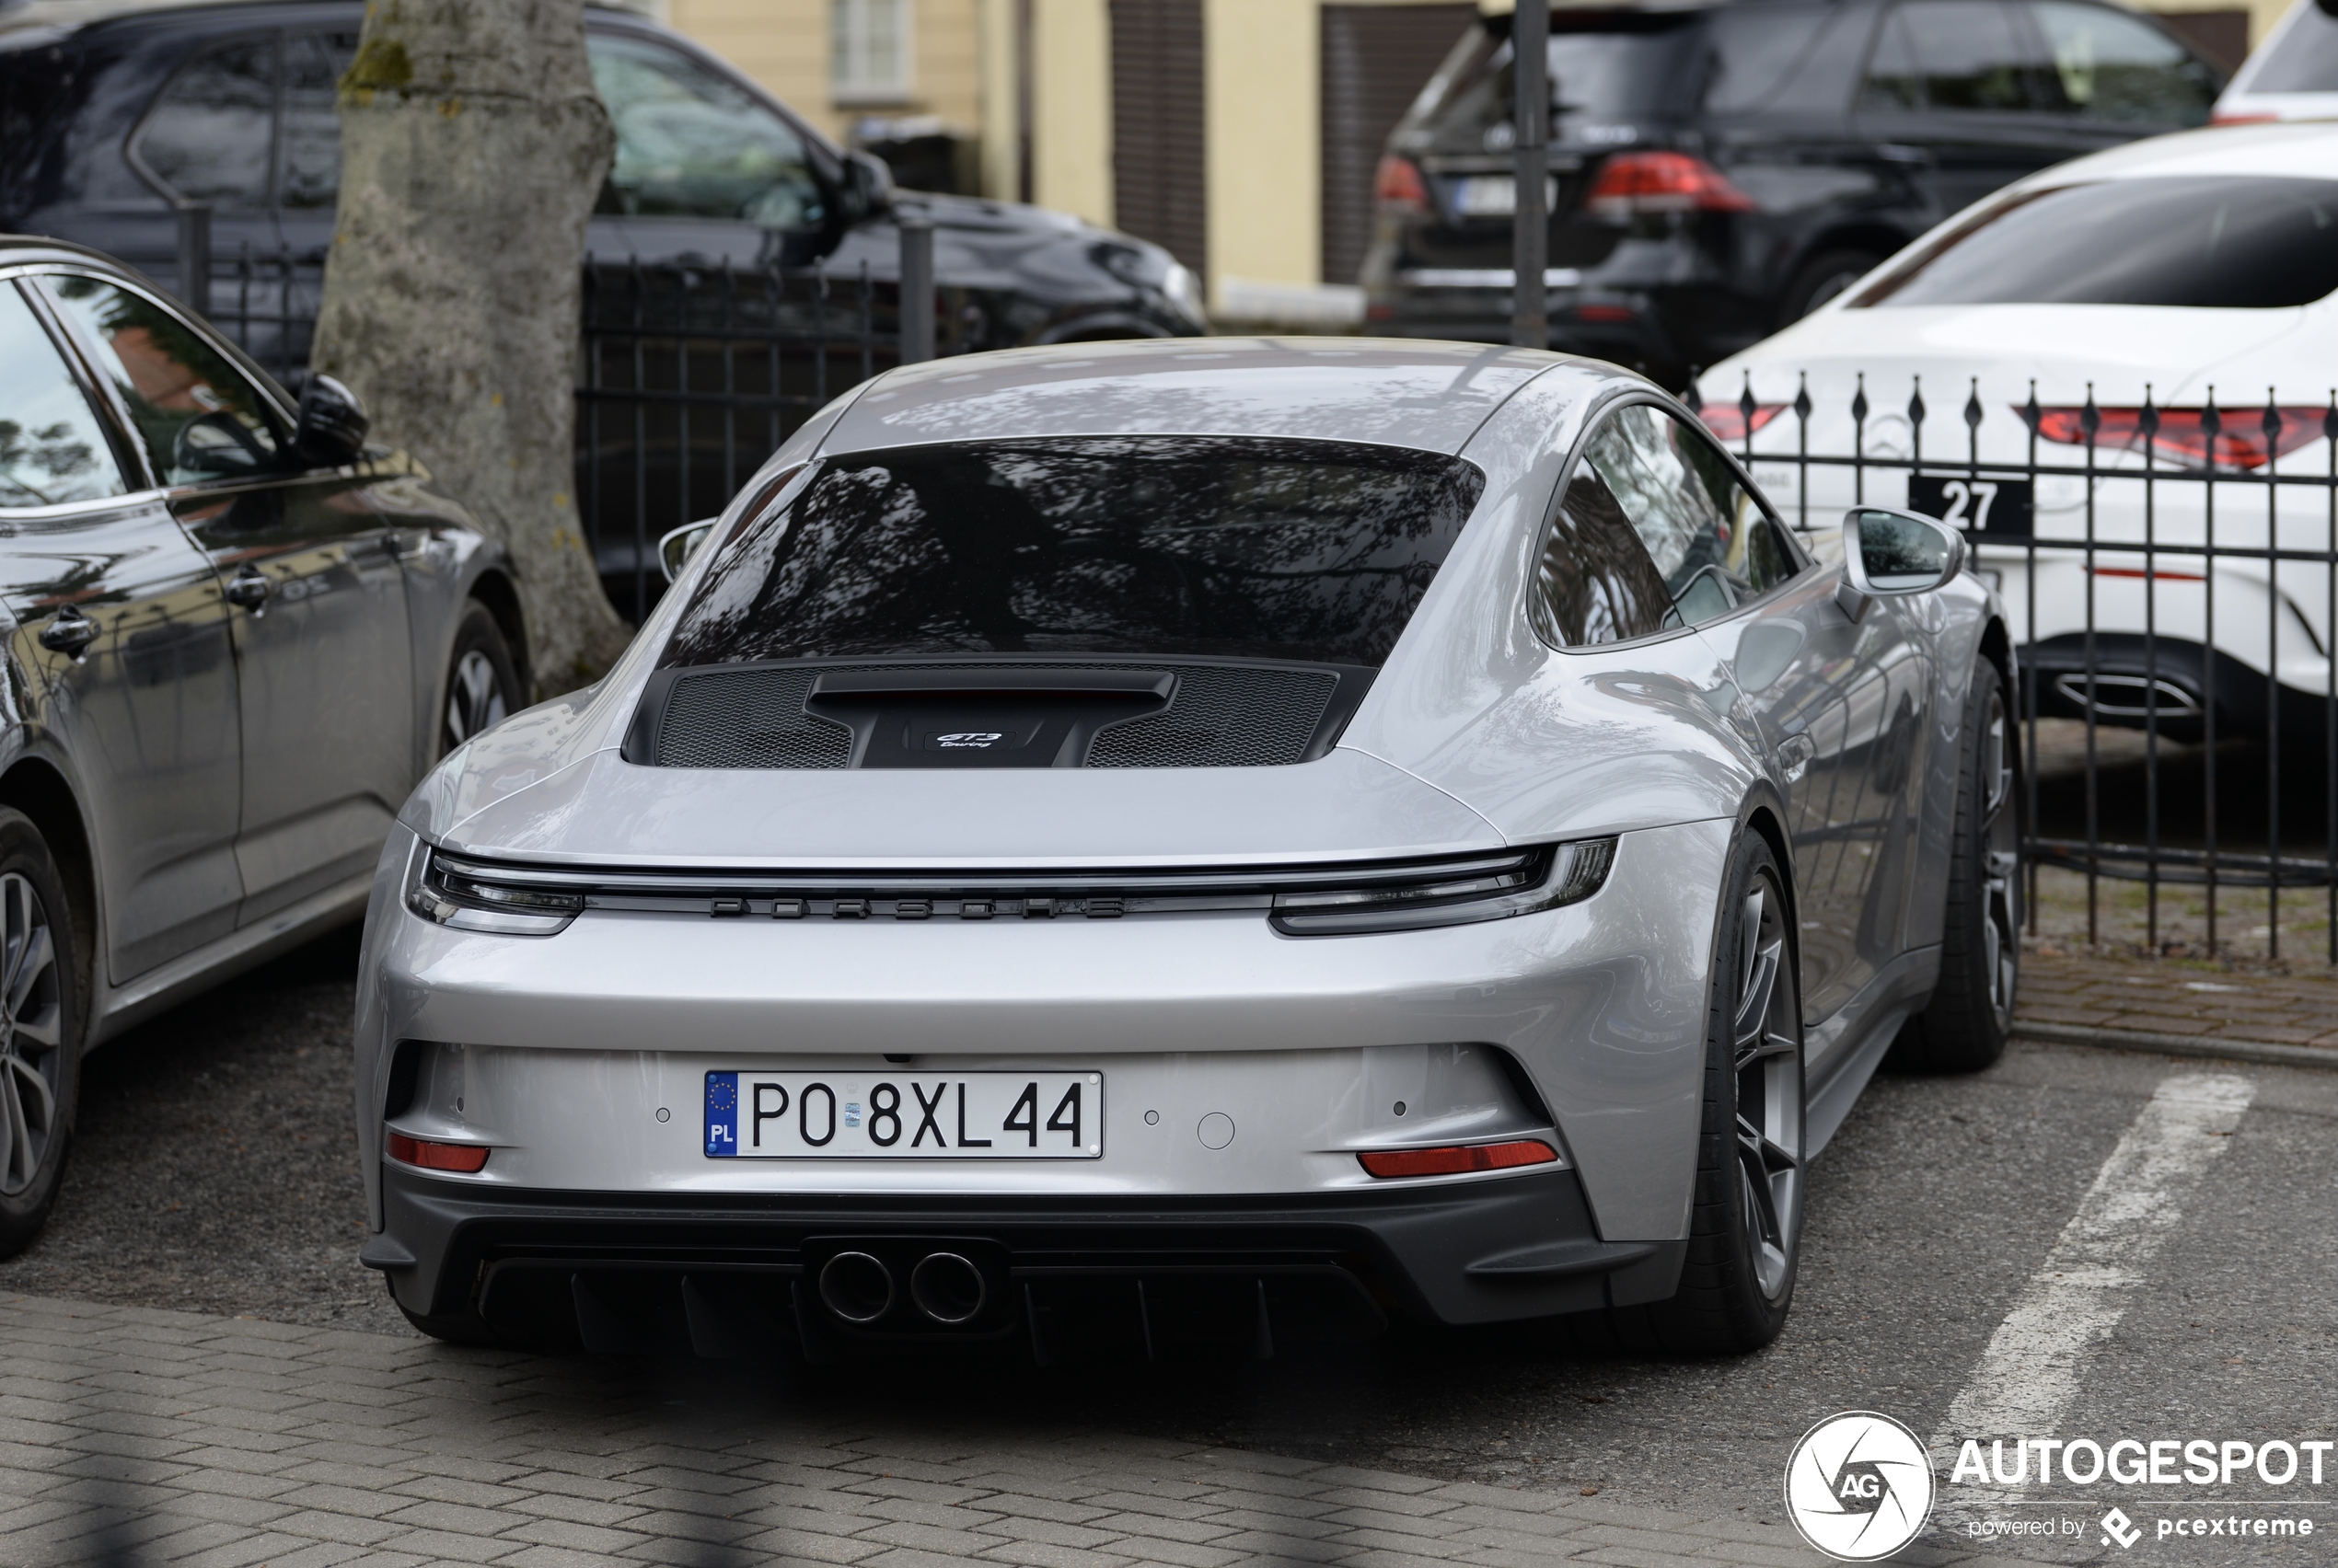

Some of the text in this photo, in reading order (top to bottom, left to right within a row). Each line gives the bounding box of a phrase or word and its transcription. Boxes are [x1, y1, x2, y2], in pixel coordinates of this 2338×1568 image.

[1942, 480, 1998, 530] 27
[937, 732, 1002, 741] GT3
[711, 897, 1124, 919] PORSCHE
[754, 1083, 1081, 1147] PO 8XL44
[710, 1125, 733, 1142] PL
